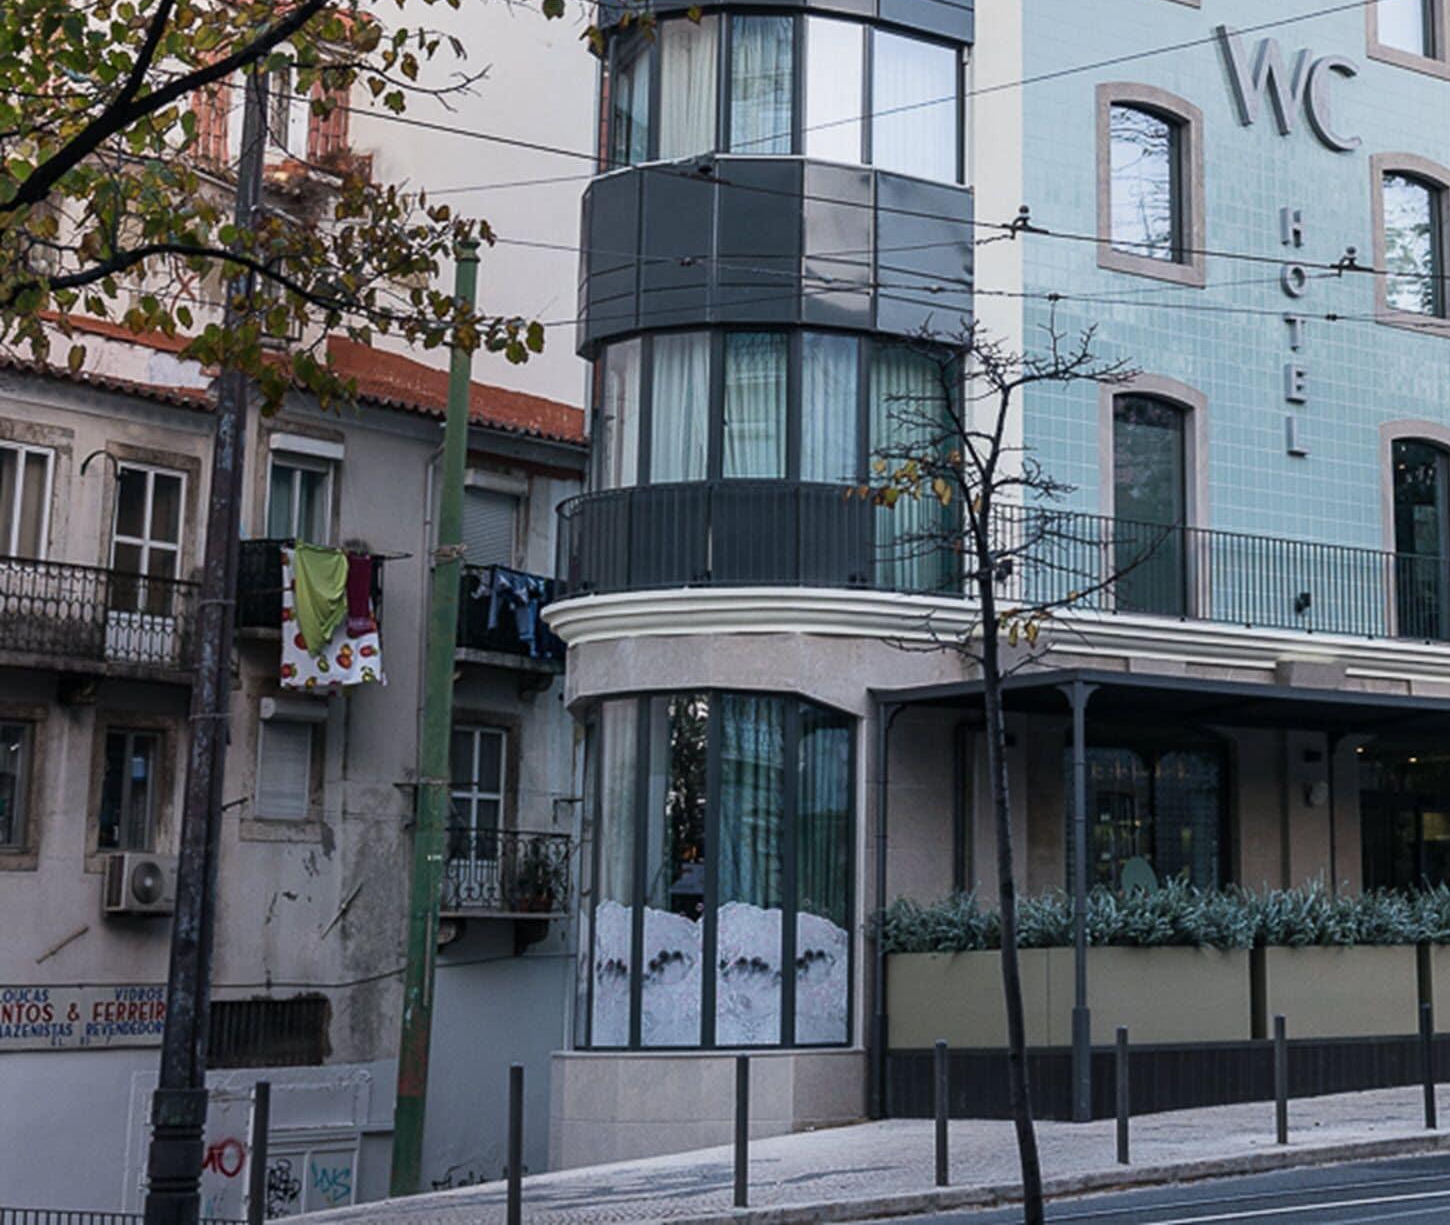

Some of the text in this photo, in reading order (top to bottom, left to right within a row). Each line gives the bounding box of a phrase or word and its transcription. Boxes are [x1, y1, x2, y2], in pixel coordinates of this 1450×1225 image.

[1214, 24, 1363, 152] WC
[1280, 206, 1309, 458] HOTEL
[114, 987, 165, 1001] VIDROS
[1, 1001, 167, 1024] NTOS & FERREIR
[86, 1020, 164, 1037] REVENDEDOR
